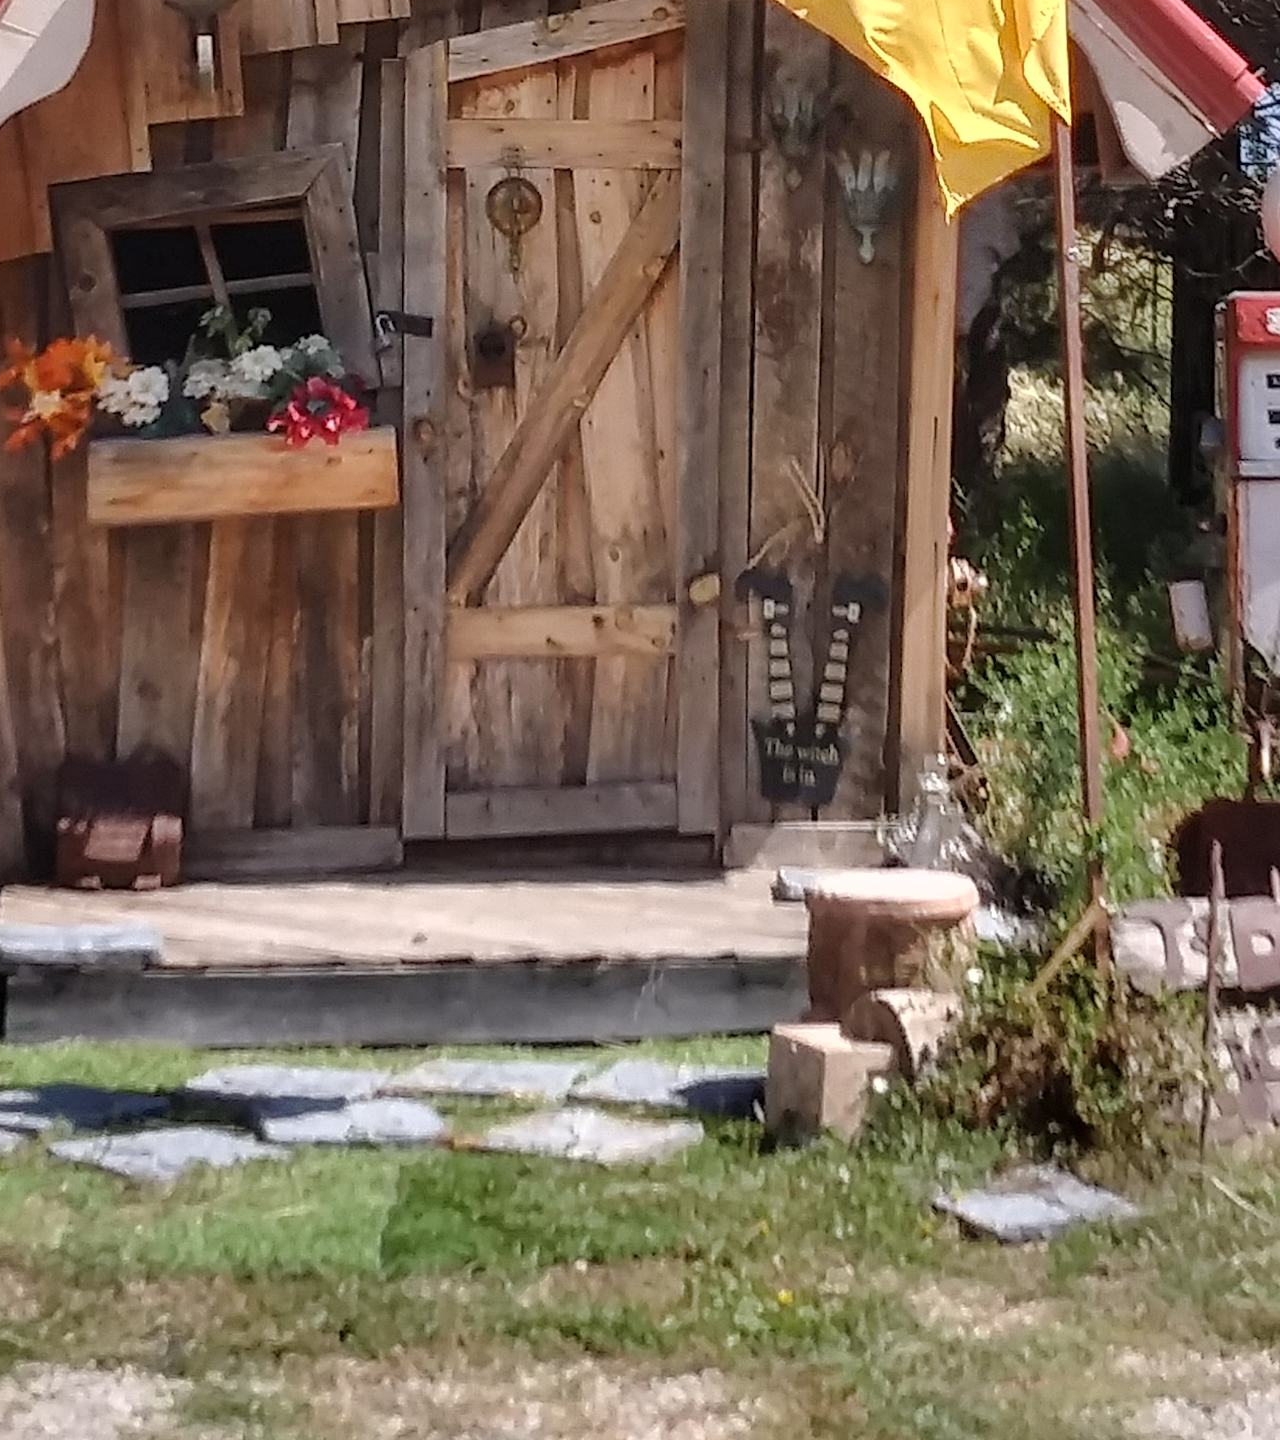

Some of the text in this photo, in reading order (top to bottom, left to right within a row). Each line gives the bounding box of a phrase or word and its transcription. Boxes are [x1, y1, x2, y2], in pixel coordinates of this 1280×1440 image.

[764, 737, 839, 766] The witch
[782, 765, 816, 787] is in
